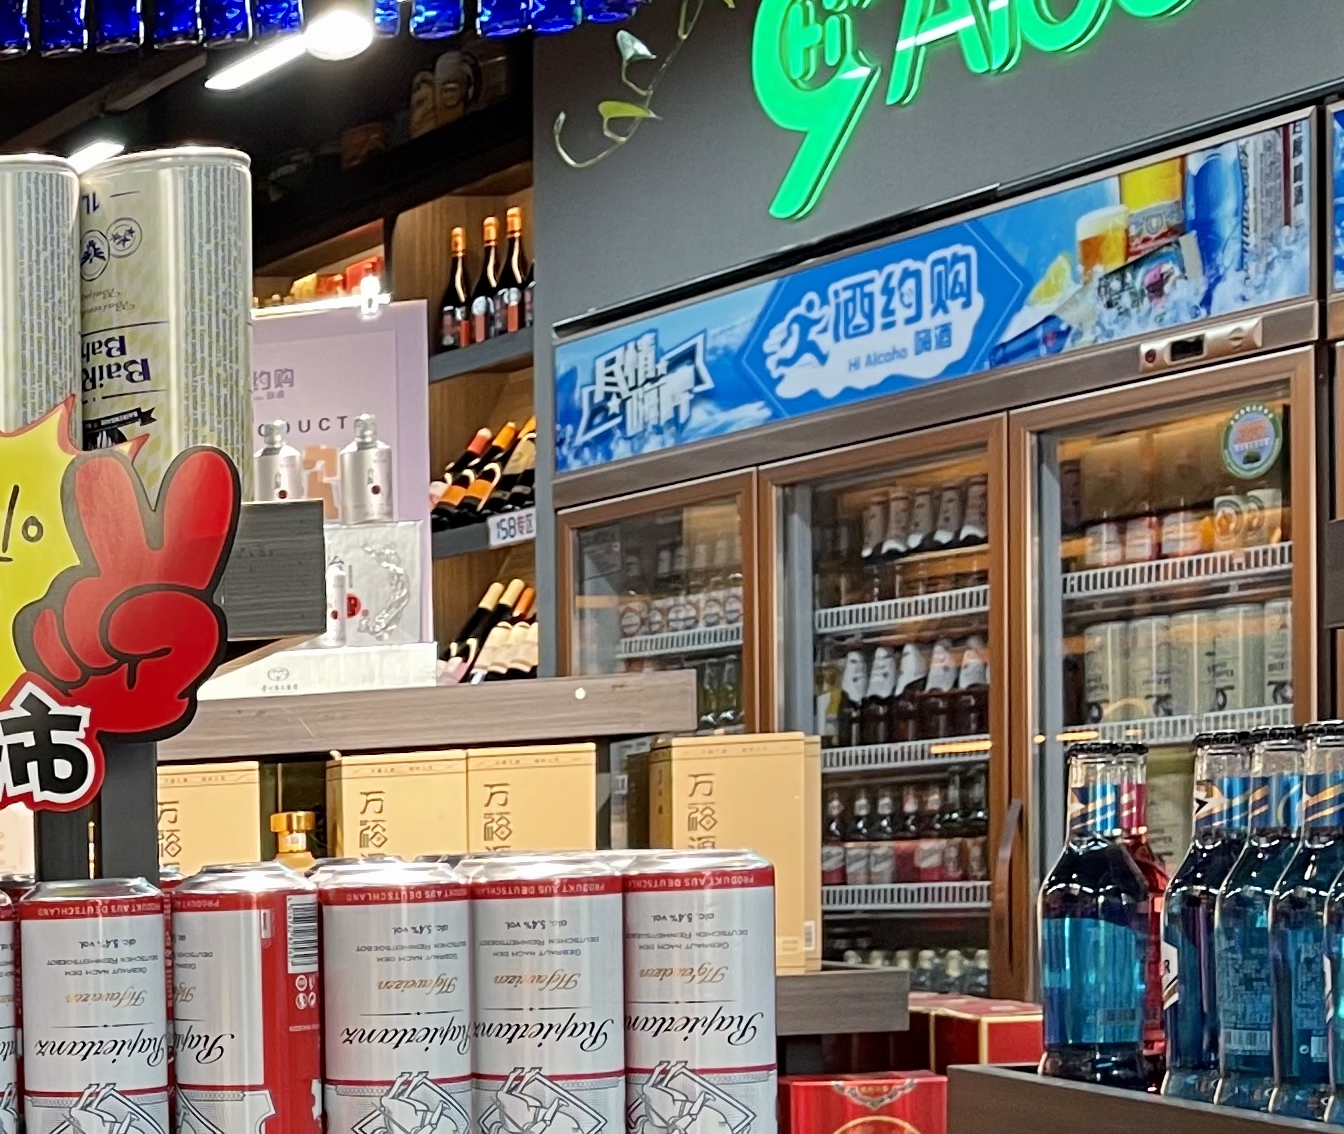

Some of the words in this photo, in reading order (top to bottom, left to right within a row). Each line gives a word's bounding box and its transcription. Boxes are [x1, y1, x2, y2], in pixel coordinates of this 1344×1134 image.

[33, 1027, 164, 1067] Rapiertanz
[340, 1016, 470, 1055] Rapiertanz
[472, 1011, 614, 1053] Rapiertanz
